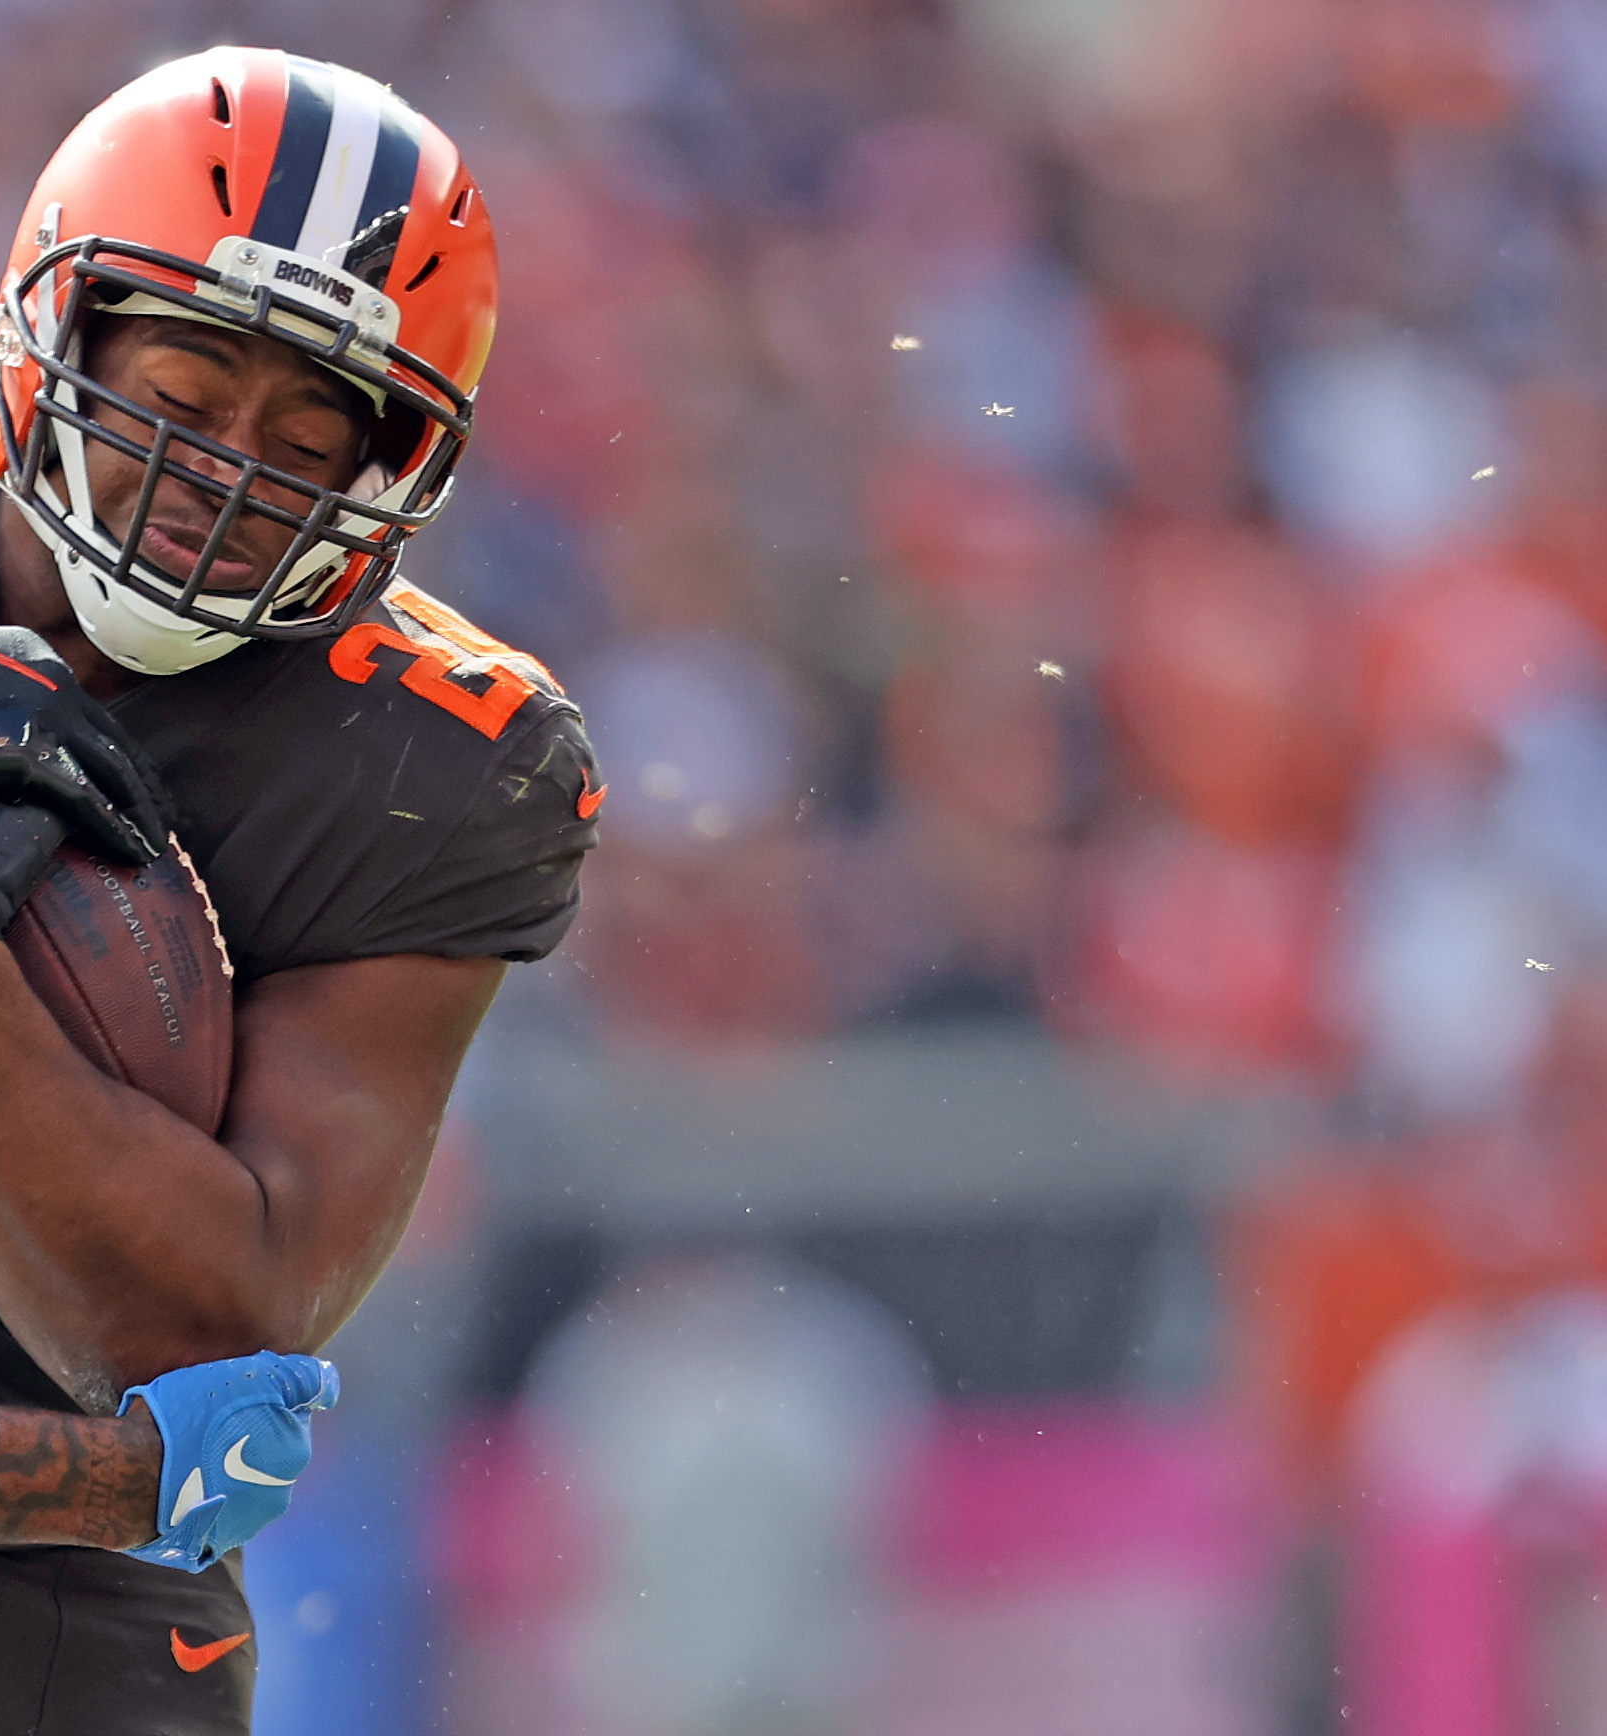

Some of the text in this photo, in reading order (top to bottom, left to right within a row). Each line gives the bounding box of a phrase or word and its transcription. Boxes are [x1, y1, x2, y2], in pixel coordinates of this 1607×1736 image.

[273, 259, 355, 307] BROWNS
[90, 859, 151, 956] OOTBALL
[147, 962, 182, 1047] LEAGUE
